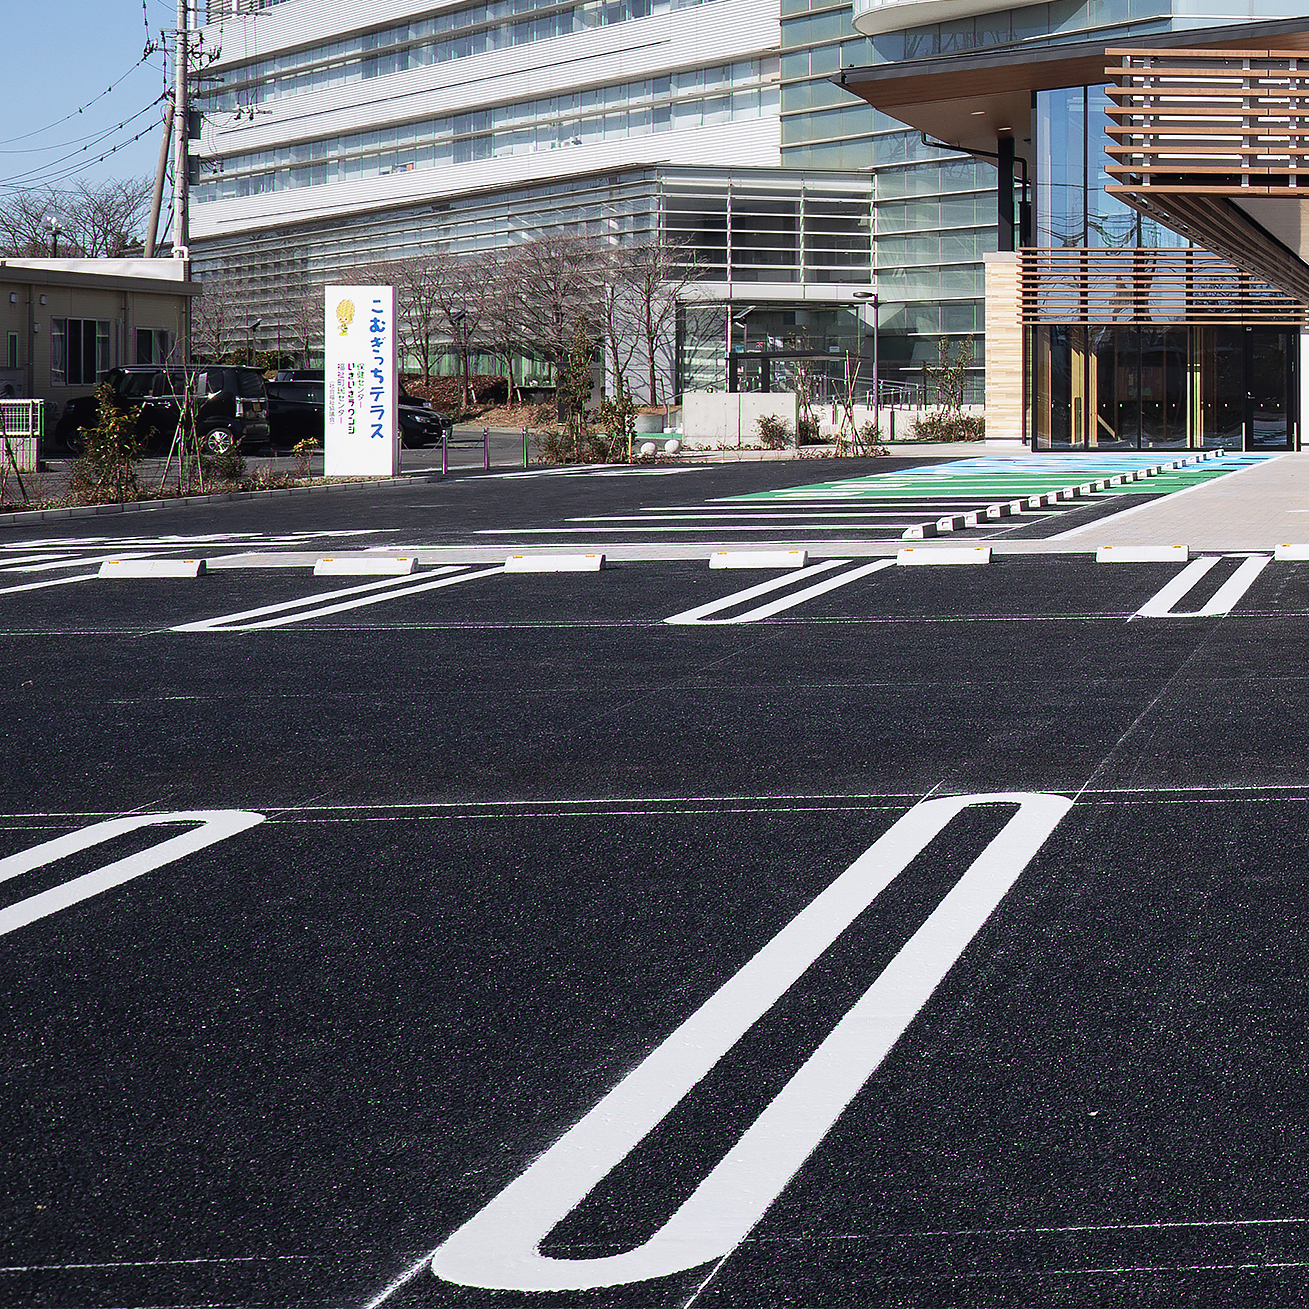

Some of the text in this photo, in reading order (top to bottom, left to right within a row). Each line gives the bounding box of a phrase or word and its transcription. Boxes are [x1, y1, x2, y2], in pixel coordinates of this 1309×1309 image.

[369, 299, 386, 439] こむぎっちテラス
